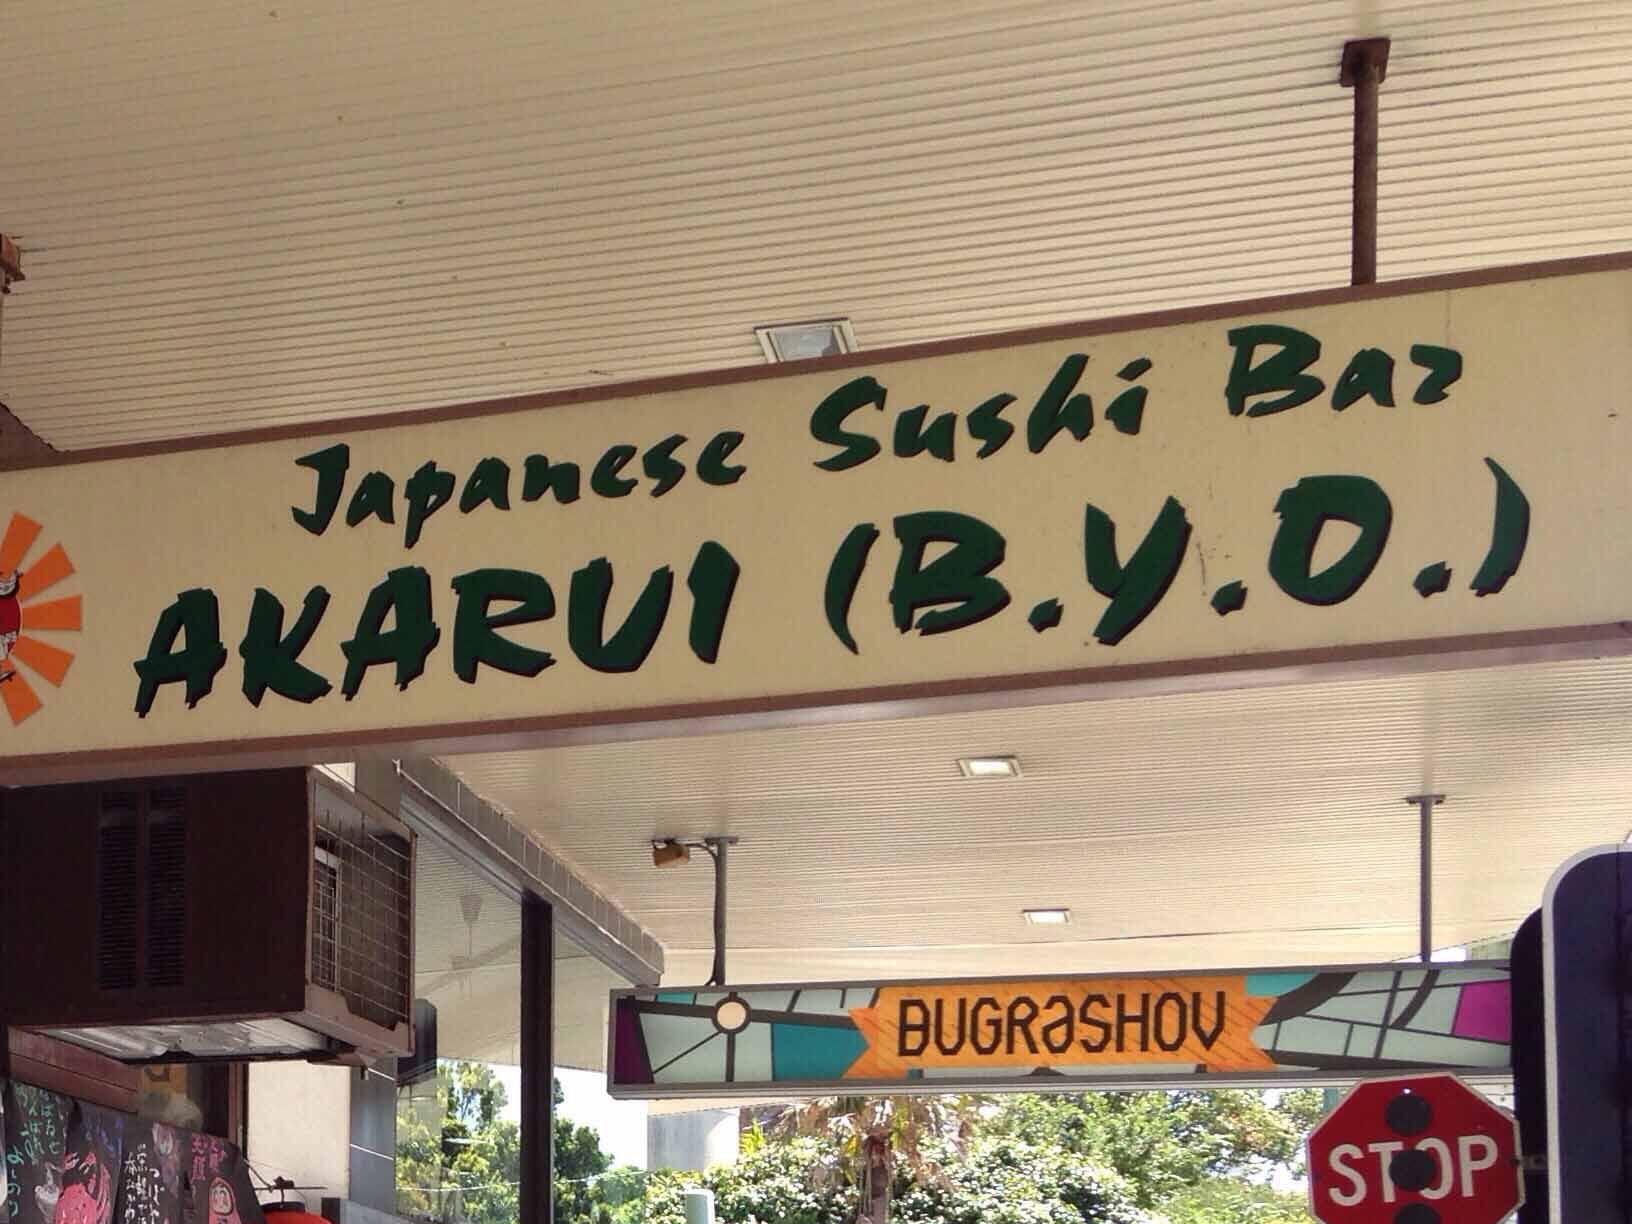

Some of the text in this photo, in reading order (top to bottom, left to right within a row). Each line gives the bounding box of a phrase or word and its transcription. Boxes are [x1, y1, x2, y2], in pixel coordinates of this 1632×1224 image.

[292, 430, 746, 549] Japanese
[812, 353, 1153, 472] Sushi
[135, 456, 1531, 718] AKARUI (B.Y.O.)
[1328, 1133, 1499, 1207] STOP
